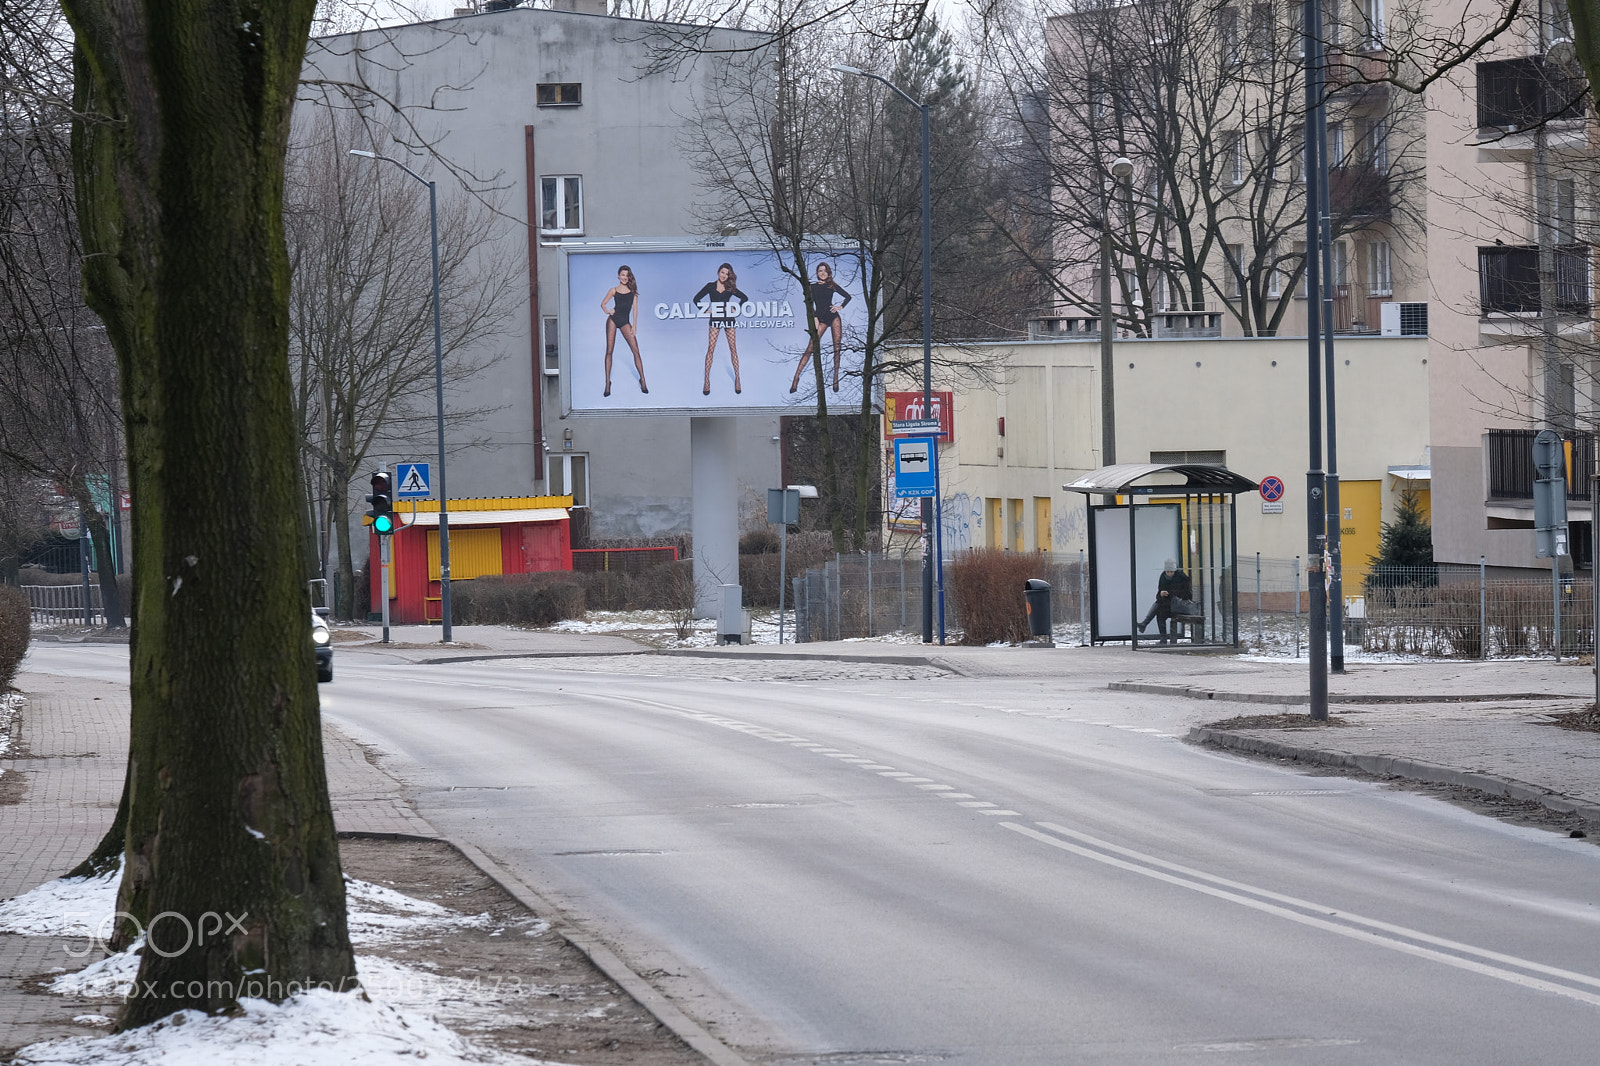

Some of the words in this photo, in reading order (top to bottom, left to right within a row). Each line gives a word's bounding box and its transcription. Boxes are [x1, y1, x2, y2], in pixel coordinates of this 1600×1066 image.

[654, 301, 794, 320] CALZEDONIA
[711, 320, 748, 329] ITALIAN
[749, 320, 795, 329] LEGWEAR
